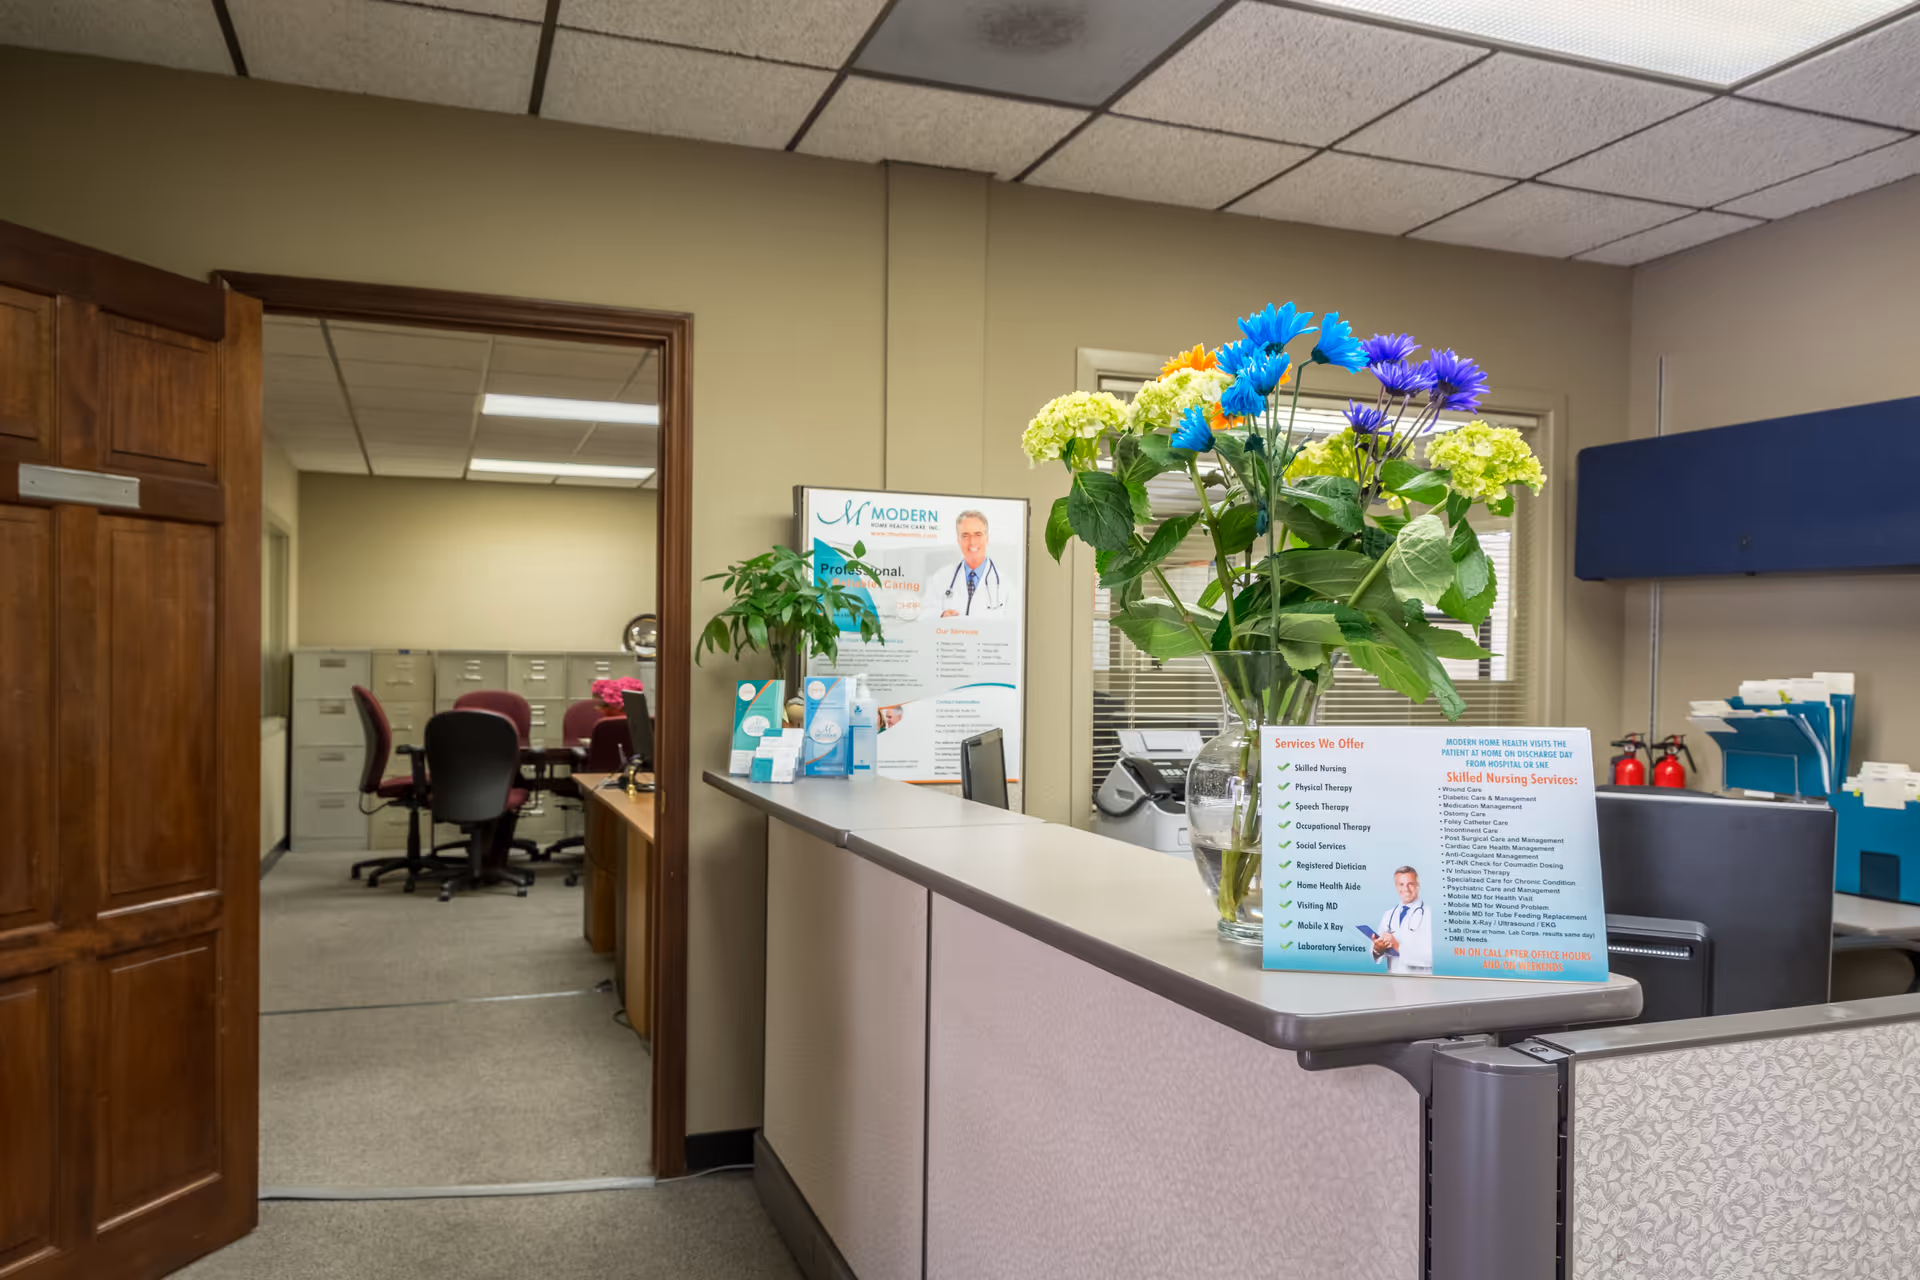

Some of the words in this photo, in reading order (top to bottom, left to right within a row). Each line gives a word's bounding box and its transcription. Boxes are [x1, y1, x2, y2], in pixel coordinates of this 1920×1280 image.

[871, 507, 938, 523] MODERN
[884, 580, 920, 592] Caring
[1275, 738, 1315, 749] Services
[1318, 738, 1335, 749] We
[1338, 738, 1364, 749] Offer
[1446, 738, 1477, 746] MODERN
[1553, 740, 1567, 748] THE
[1504, 750, 1515, 758] ON
[1295, 764, 1318, 772] Skilled
[1320, 765, 1347, 774] Nursing
[1447, 772, 1482, 783] Skilled
[1487, 773, 1528, 787] Nursing
[1531, 774, 1577, 785] Services:
[1295, 783, 1322, 792] Physical
[1325, 784, 1352, 793] Therapy
[1296, 803, 1319, 812] Speech
[1321, 803, 1349, 812] Therapy
[1296, 822, 1341, 831] Occupational
[1343, 823, 1371, 832] Therapy
[1296, 841, 1316, 849] Social
[1318, 842, 1346, 850] Services
[1297, 861, 1333, 871] Registered
[1336, 862, 1367, 871] Dietician
[1540, 862, 1563, 870] Dosing
[1297, 881, 1317, 889] Home
[1320, 882, 1343, 890] Health
[1297, 902, 1324, 911] Visiting
[1326, 902, 1338, 910] MD
[1298, 922, 1322, 930] Mobile
[1331, 923, 1343, 932] Ray
[1298, 942, 1336, 953] Laboratory
[1338, 944, 1366, 952] Services
[1454, 948, 1465, 956] RN
[1468, 948, 1480, 957] ON
[1484, 949, 1502, 957] CALL
[1504, 949, 1528, 958] AFTER
[1531, 951, 1559, 959] OFFICE
[1562, 952, 1591, 961] HOURS
[1483, 961, 1500, 969] AND
[1503, 961, 1516, 970] ON
[1518, 962, 1563, 972] WEEKENDS
